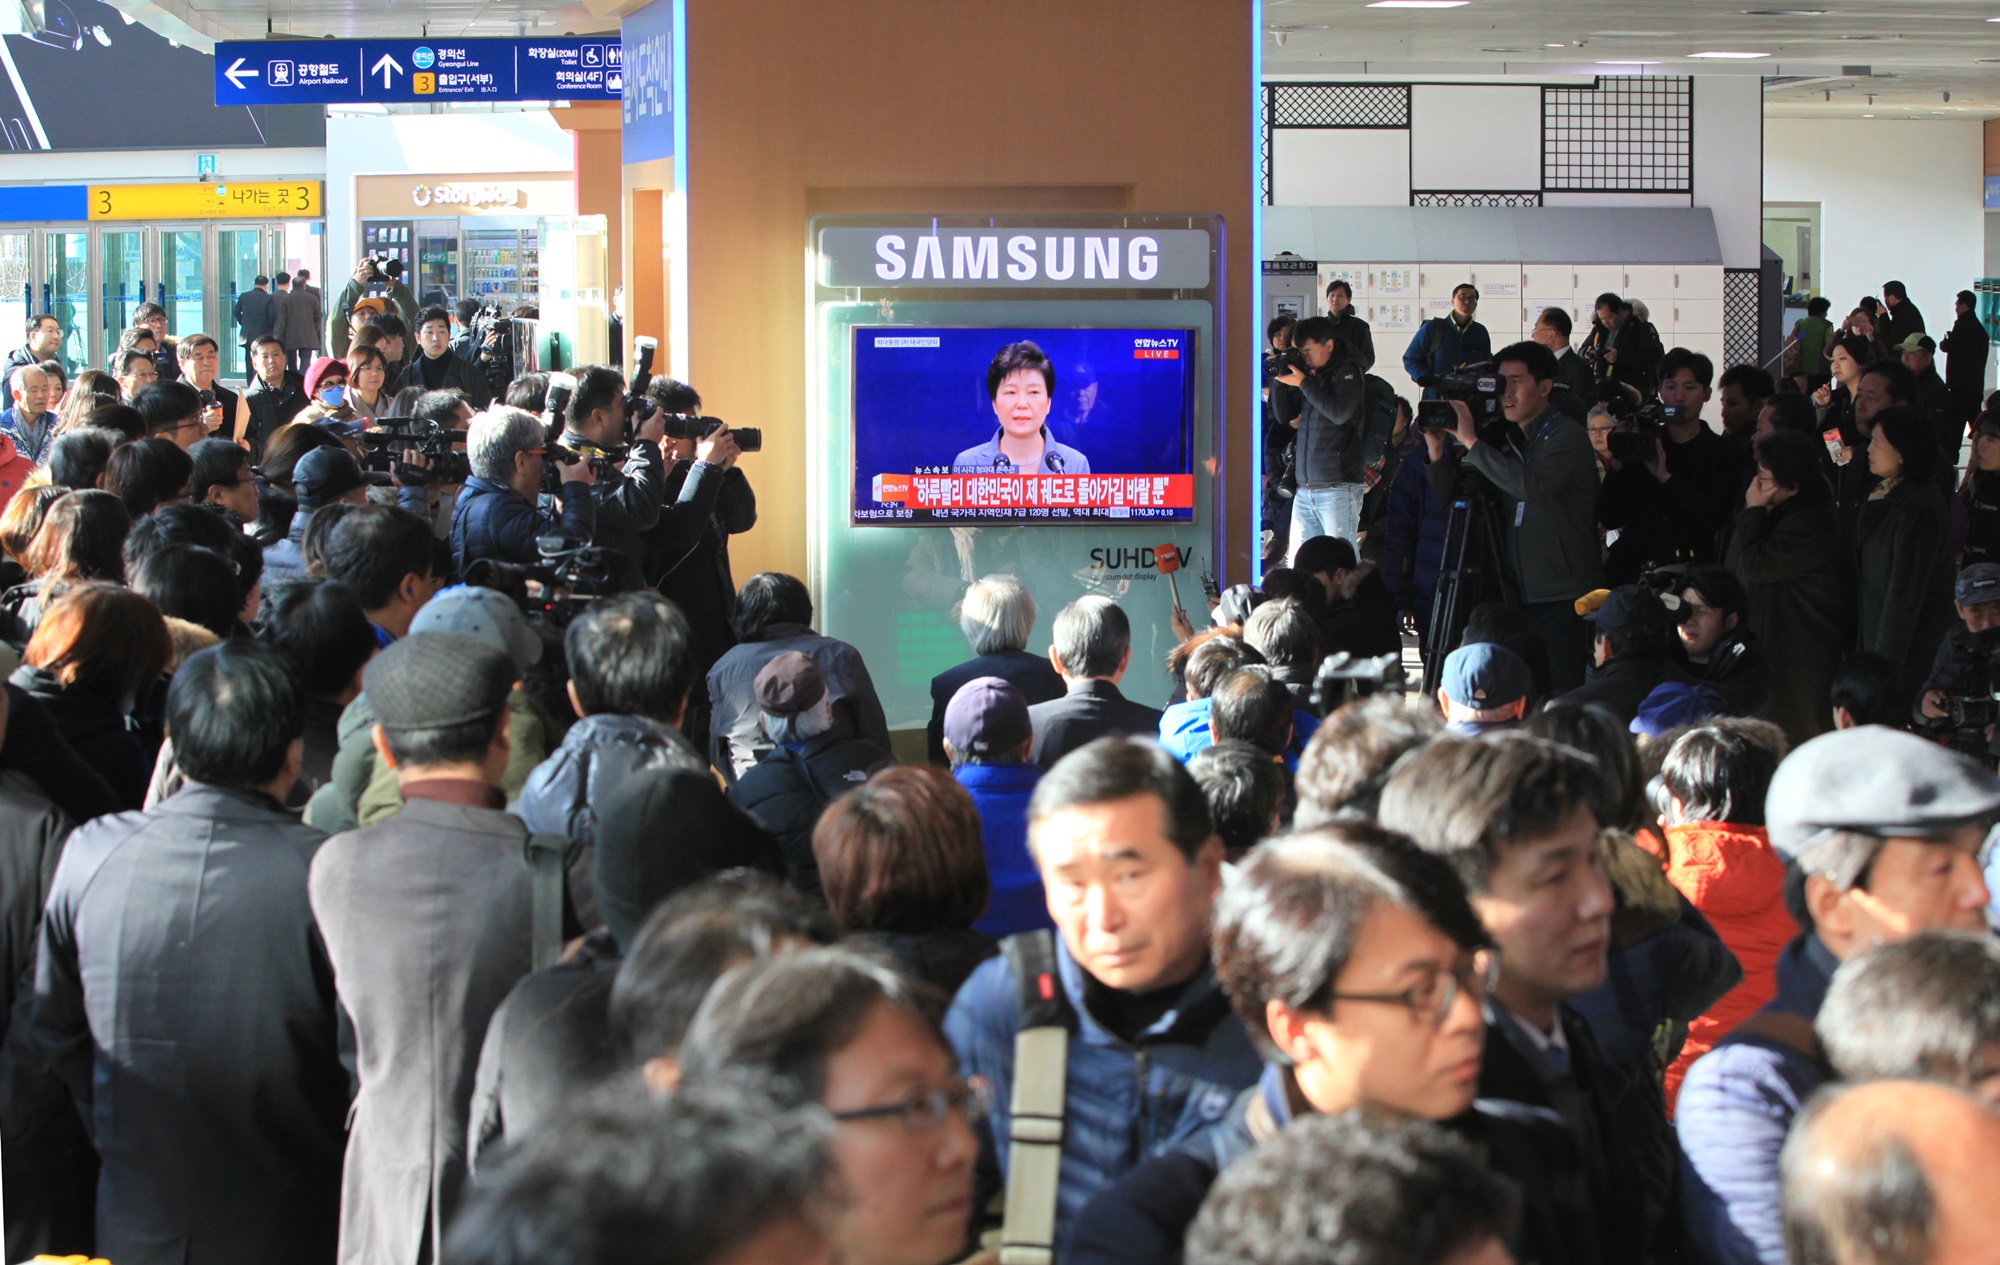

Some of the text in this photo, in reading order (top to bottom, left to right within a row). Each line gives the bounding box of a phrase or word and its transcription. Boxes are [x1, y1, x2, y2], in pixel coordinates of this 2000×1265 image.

[438, 48, 465, 60] 경의선
[528, 47, 578, 59] 화장실(20M)
[298, 64, 339, 77] 공항철도
[438, 61, 465, 69] Gyeongui
[299, 77, 348, 86] Airport Railroad
[438, 73, 494, 86] 출입구(서부)
[556, 71, 603, 83] 회의실(4F)
[624, 31, 672, 124] 열차도착안내
[420, 76, 429, 92] 3
[99, 190, 112, 214] 3
[233, 189, 289, 205] 나가는 곳
[296, 186, 310, 211] 3
[875, 235, 1158, 280] SAMSUNG
[1134, 338, 1179, 348] 연합뉴스TV
[1144, 350, 1169, 358] LIVE
[1478, 381, 1495, 389] OBS
[953, 466, 960, 474] 이
[961, 466, 975, 474] 시각
[913, 477, 963, 506] "하루빨리
[966, 477, 1023, 506] 대한민국이
[1025, 477, 1038, 505] 제
[1040, 477, 1075, 505] 궤도로
[1077, 477, 1124, 505] 돌아가길
[1126, 477, 1150, 505] 바랄
[895, 509, 913, 518] 보장
[932, 508, 948, 517] 내년
[951, 508, 976, 517] 국가직
[978, 508, 1012, 517] 지역인재
[1014, 508, 1026, 517] 7급
[1029, 508, 1049, 517] 120명
[1051, 508, 1071, 517] 선발,
[1073, 508, 1090, 517] 역대
[1130, 508, 1155, 517] 1170.30
[1160, 508, 1174, 517] 0.10
[1090, 547, 1156, 569] SUHD
[1122, 572, 1133, 581] dot
[1134, 572, 1157, 583] display
